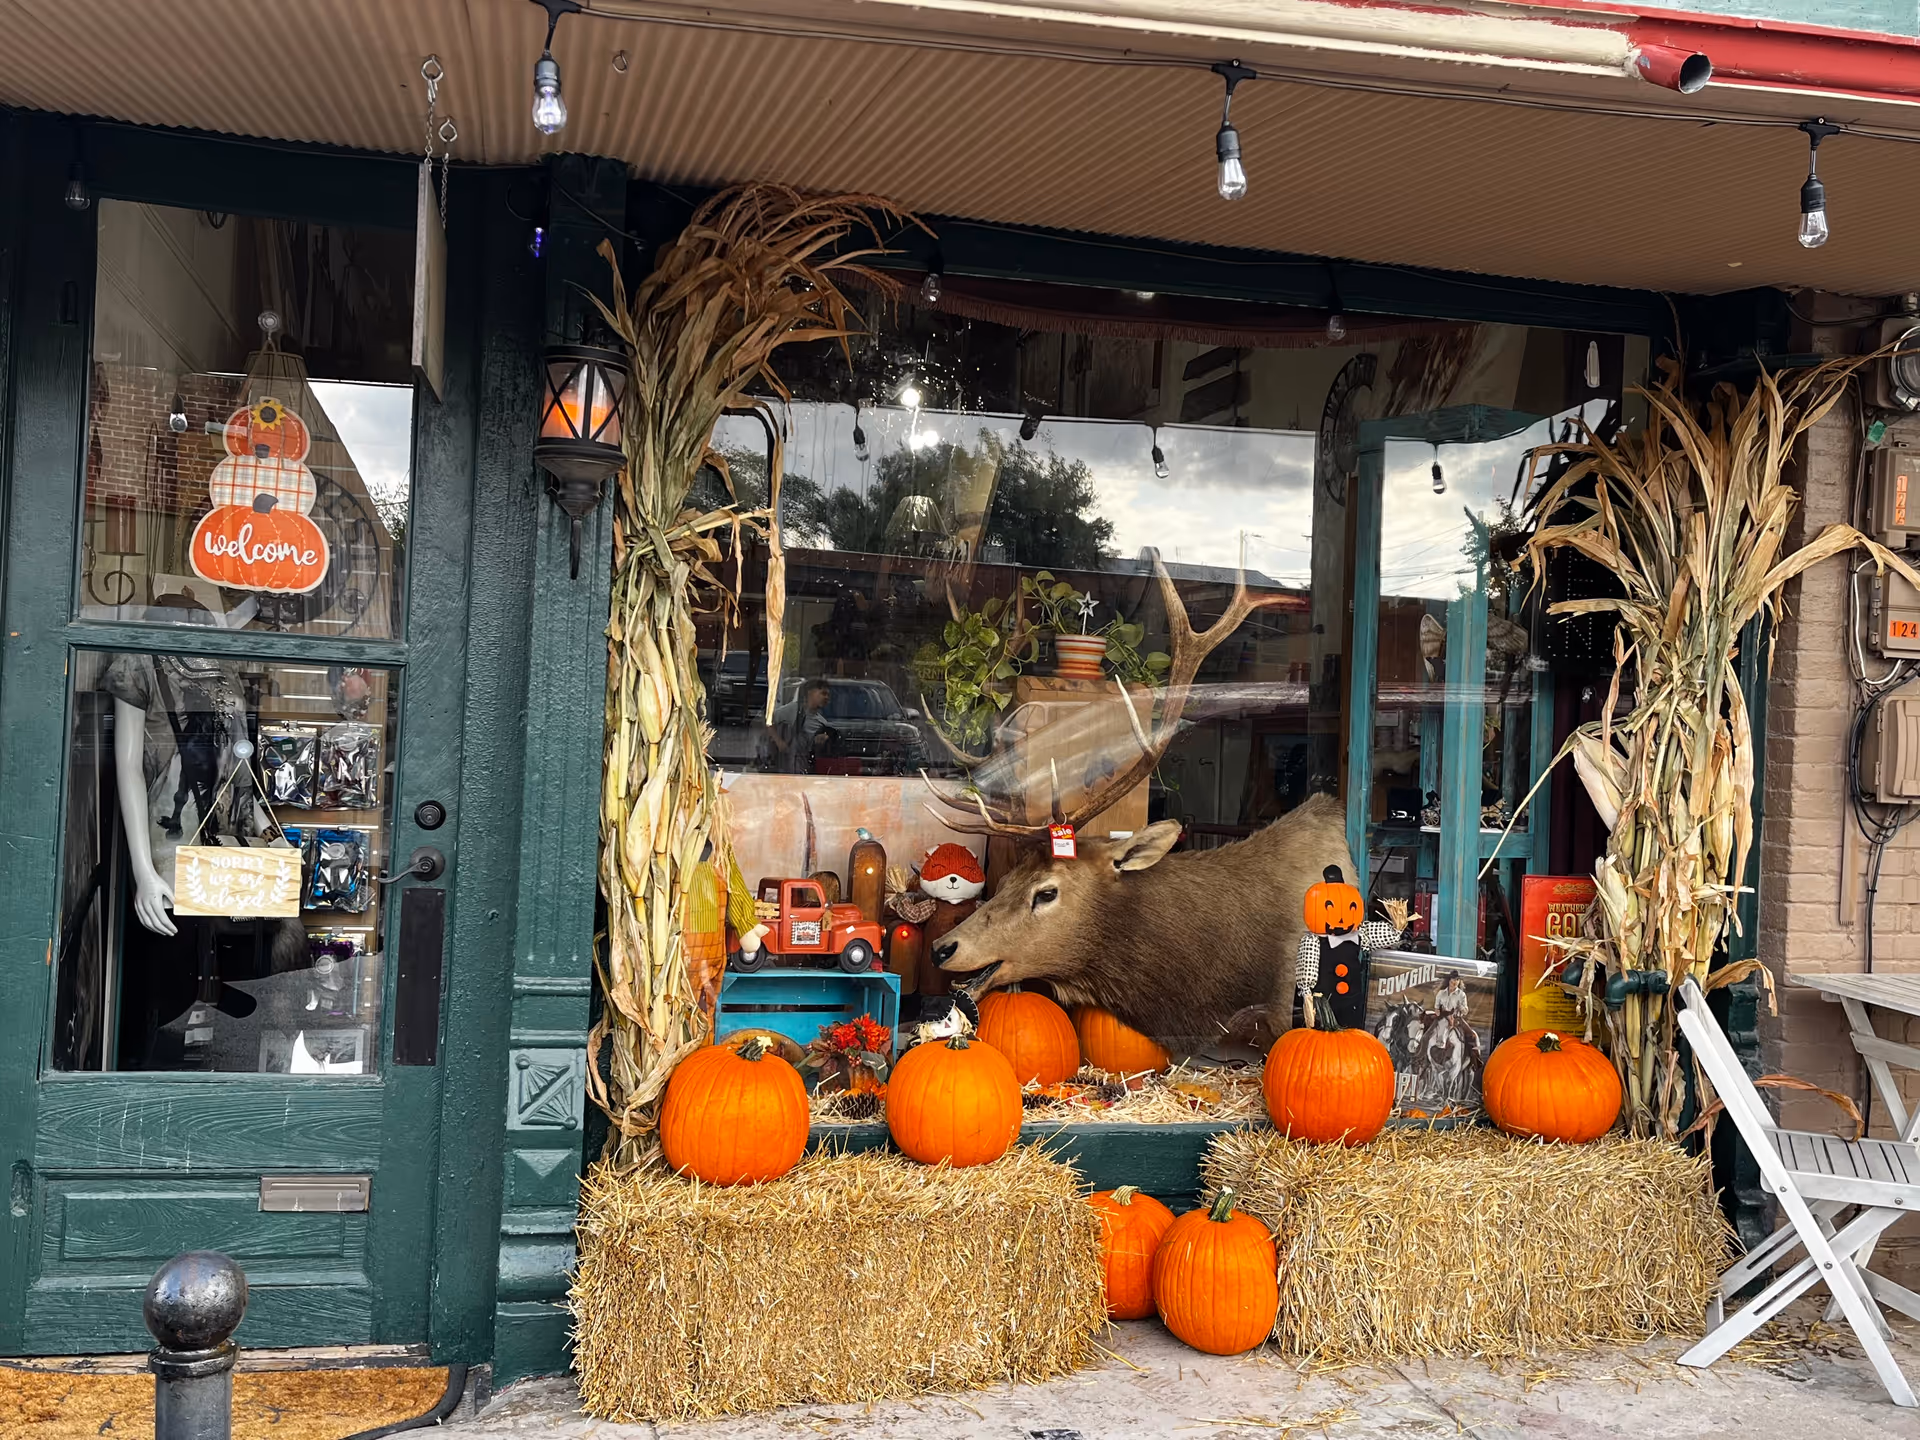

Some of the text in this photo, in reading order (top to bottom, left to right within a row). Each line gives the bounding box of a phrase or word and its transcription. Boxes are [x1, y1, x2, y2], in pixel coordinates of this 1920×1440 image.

[204, 523, 318, 566] welcome
[1892, 621, 1918, 637] 124
[210, 855, 265, 869] SORRY
[209, 872, 265, 888] we are
[208, 887, 268, 910] closed
[1377, 963, 1439, 996] COWGIRL
